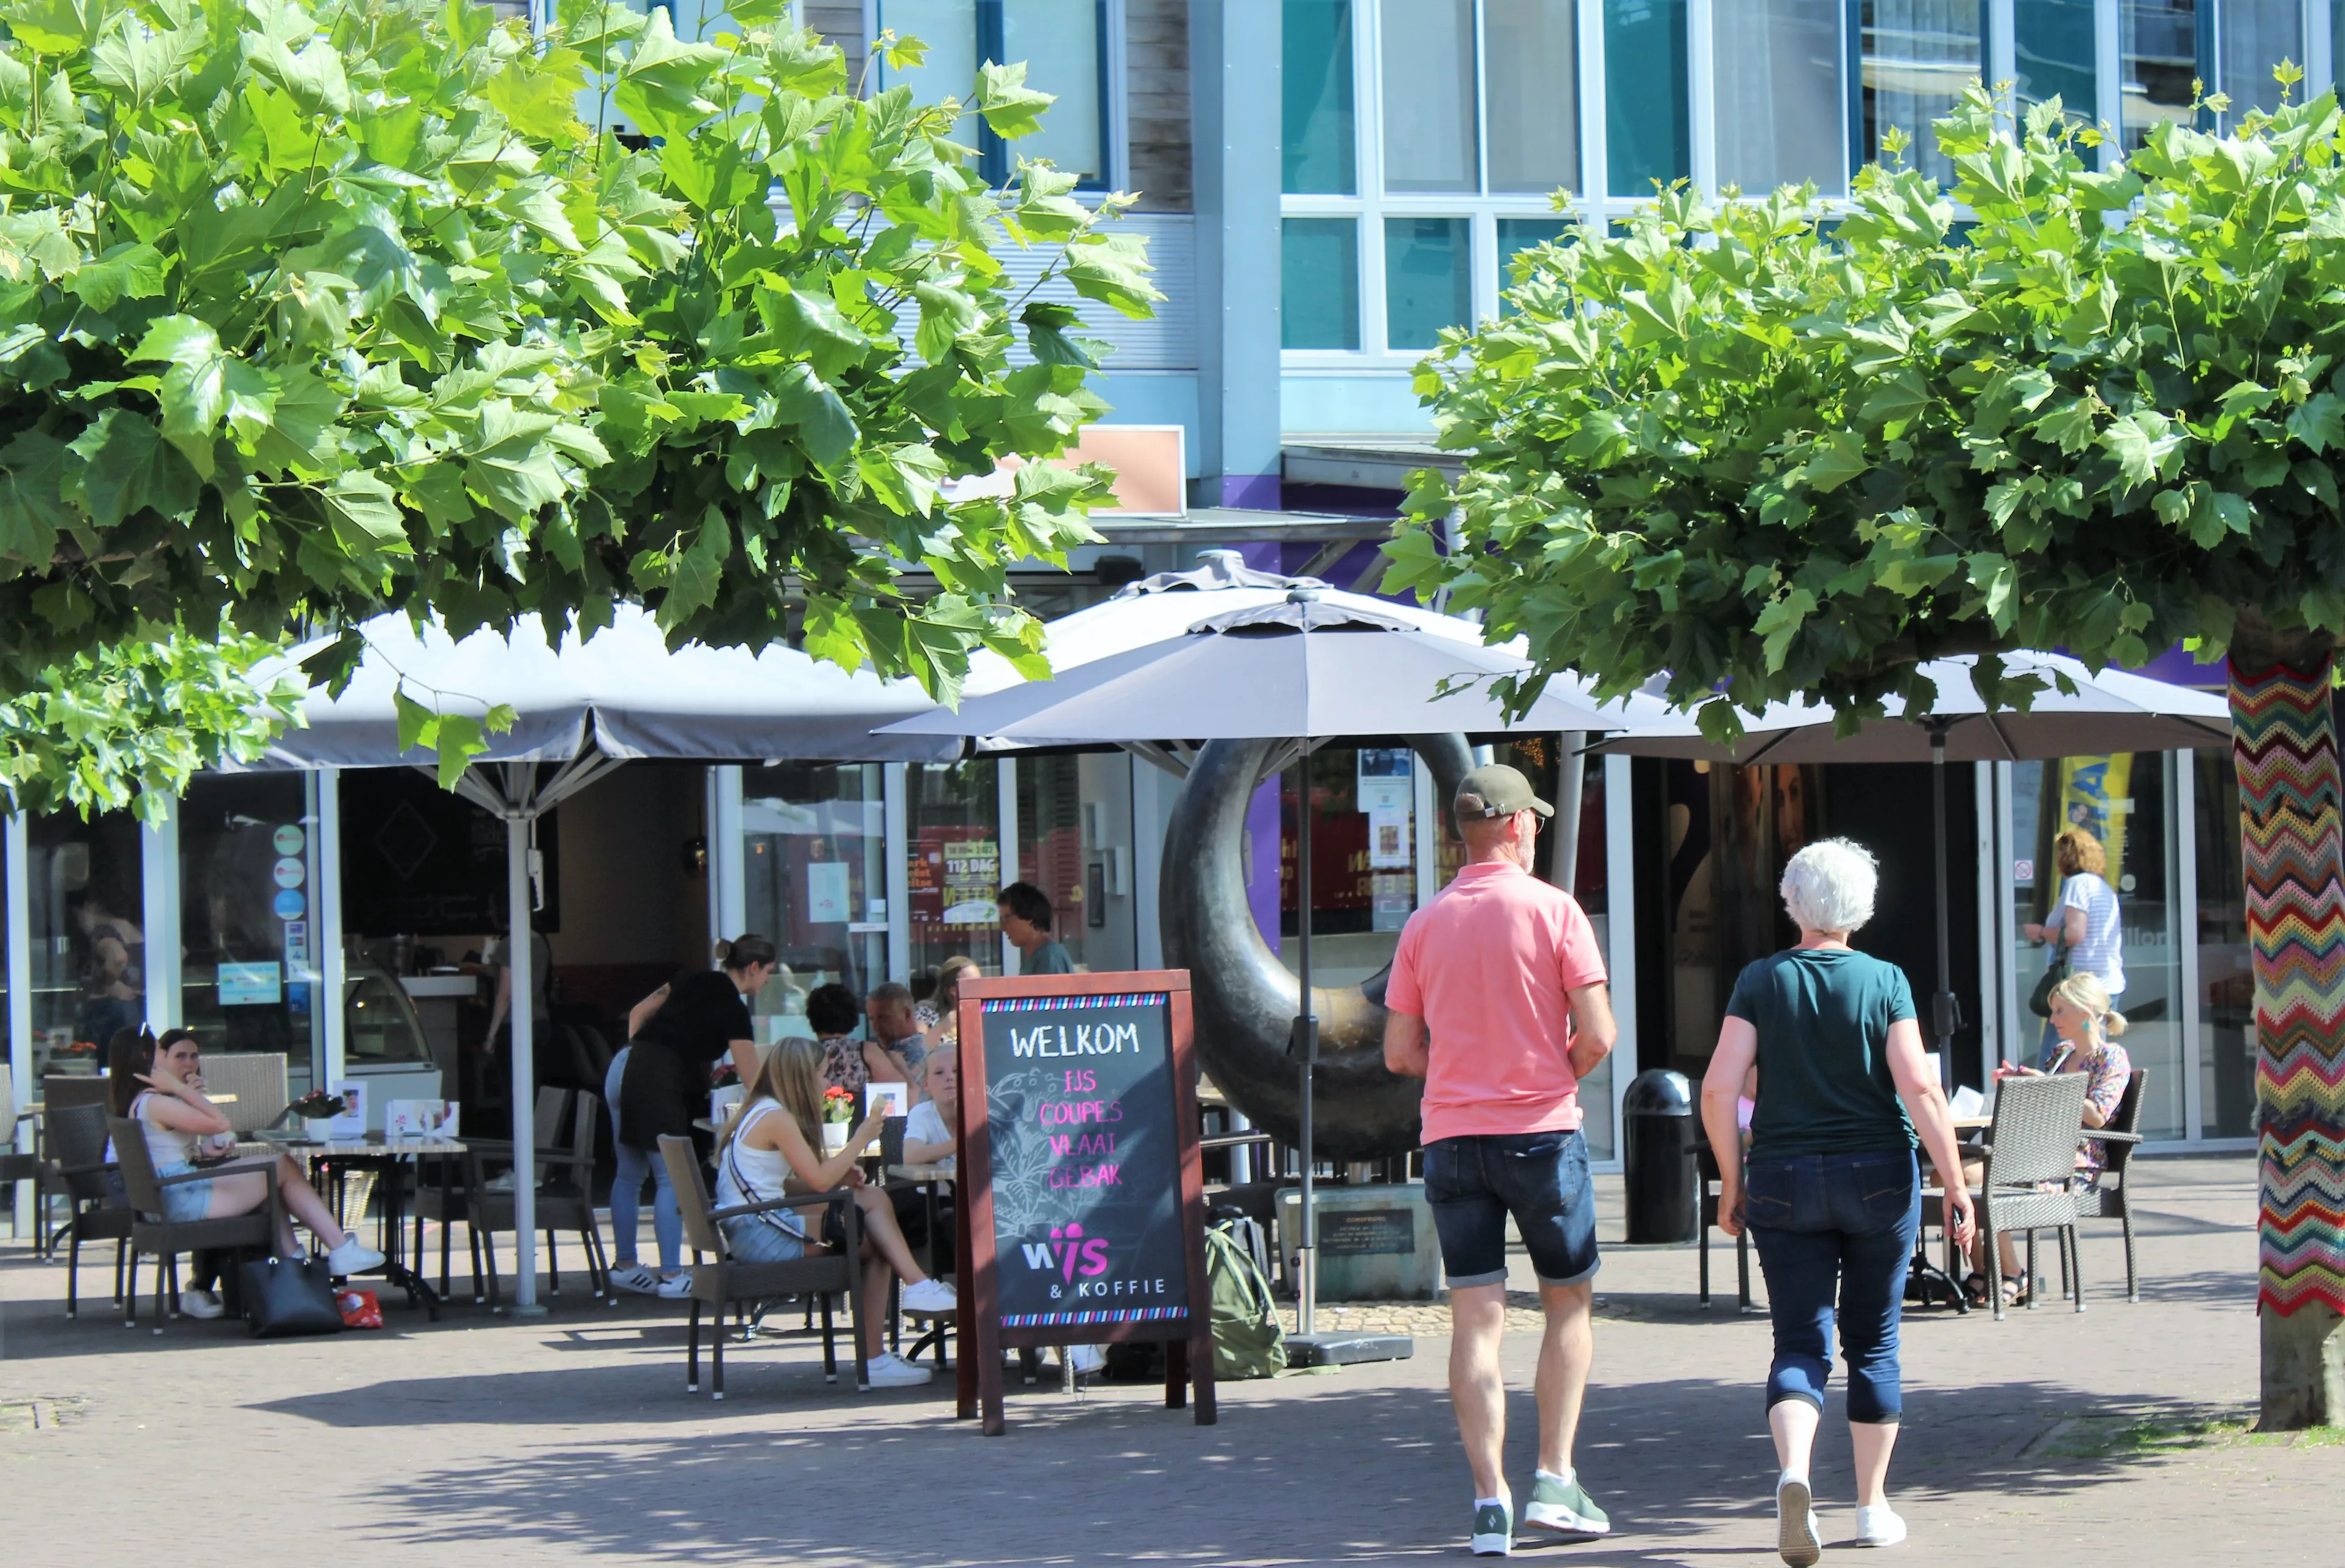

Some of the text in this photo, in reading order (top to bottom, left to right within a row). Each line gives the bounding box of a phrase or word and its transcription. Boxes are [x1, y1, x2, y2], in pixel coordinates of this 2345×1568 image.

[946, 859, 995, 873] 112 DAG
[1010, 1022, 1140, 1058] WELKOM
[1063, 1069, 1097, 1093] IJS
[1040, 1100, 1123, 1125] COUPES
[1049, 1133, 1116, 1156] VLAAI
[1049, 1164, 1123, 1189] GEBAK
[1050, 1279, 1165, 1299] & KOFFIE
